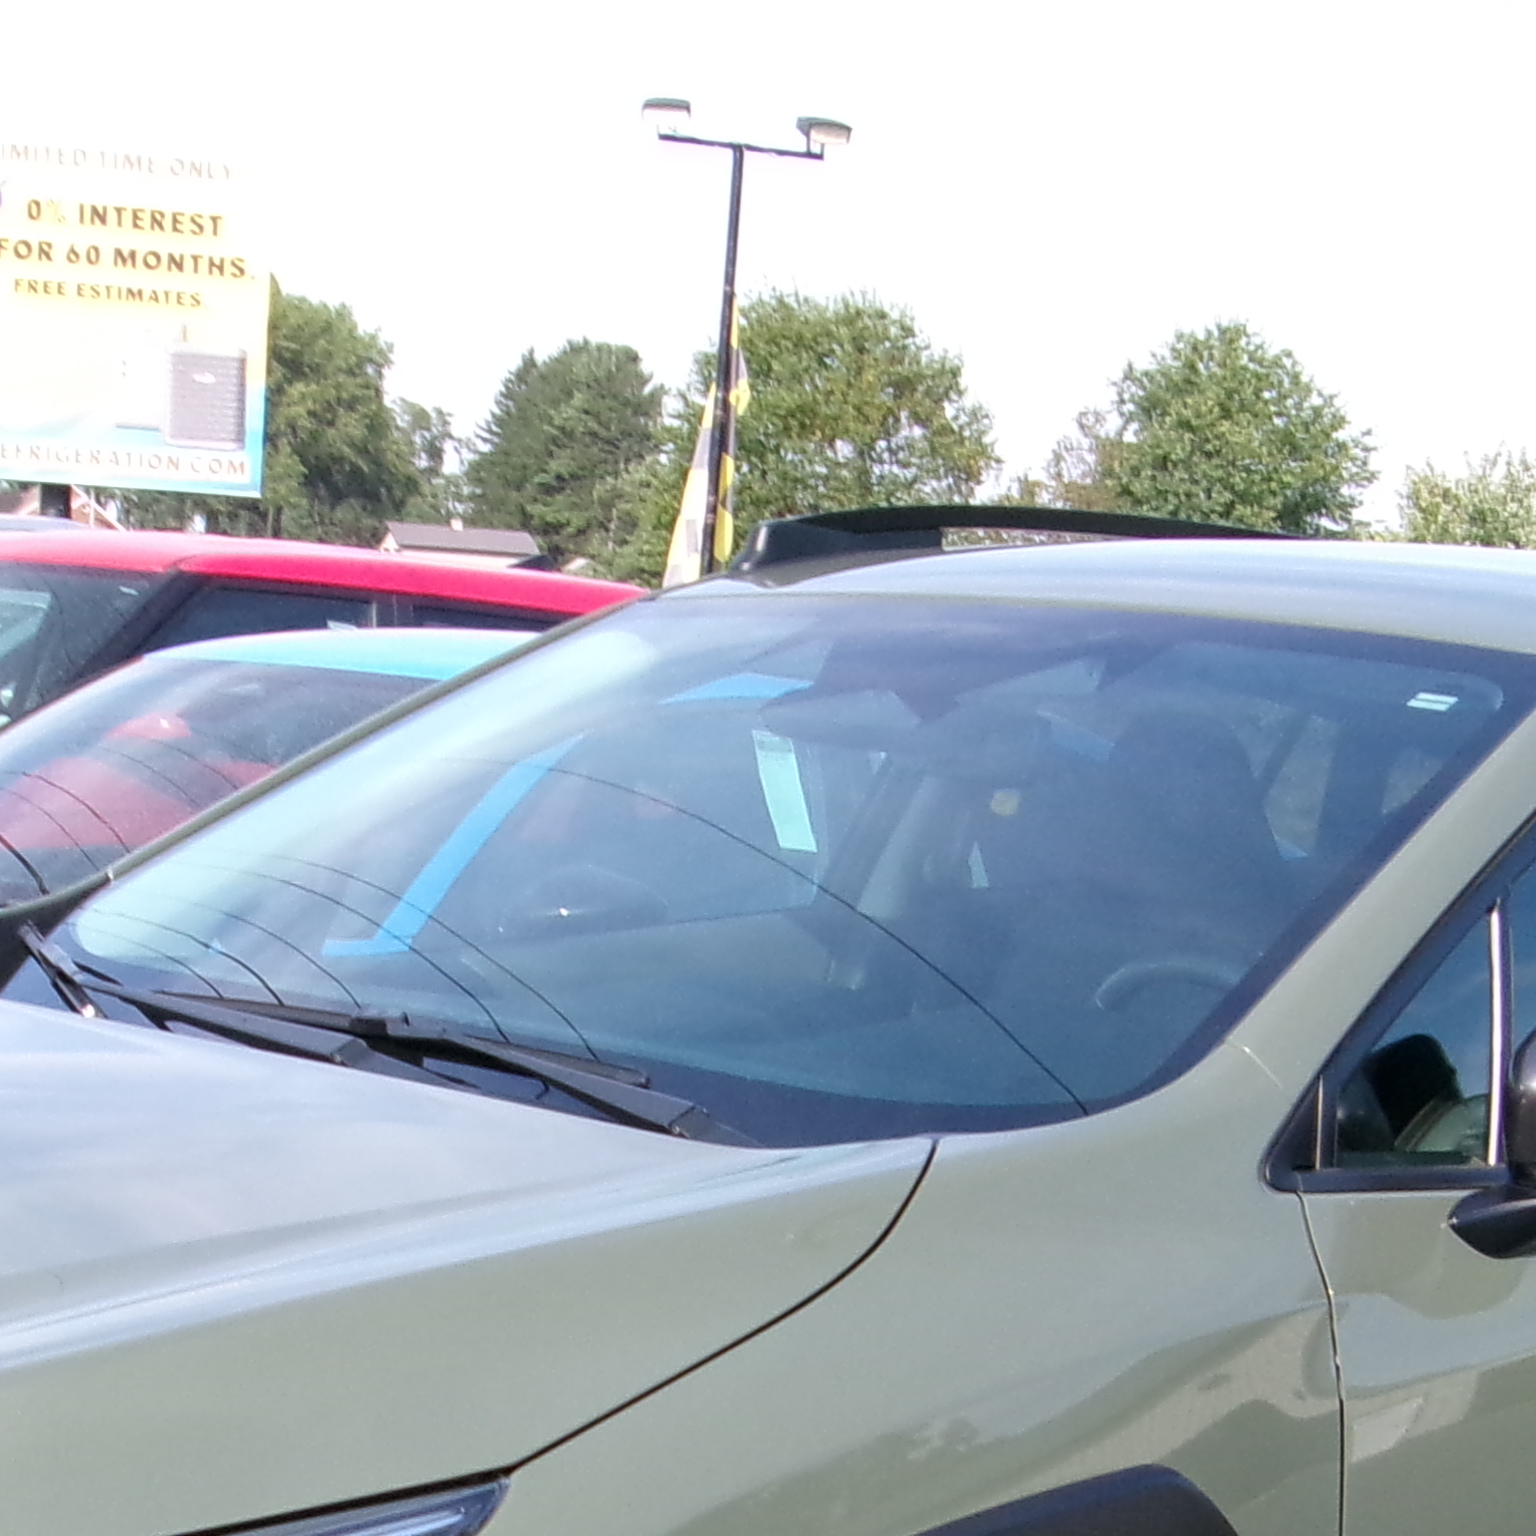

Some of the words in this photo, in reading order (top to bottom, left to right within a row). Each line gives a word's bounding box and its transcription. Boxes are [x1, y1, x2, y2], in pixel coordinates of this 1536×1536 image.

[99, 151, 156, 174] TIME
[169, 157, 232, 181] ONLY
[78, 202, 224, 237] INTEREST
[65, 243, 101, 266] 60
[14, 278, 67, 296] FREE
